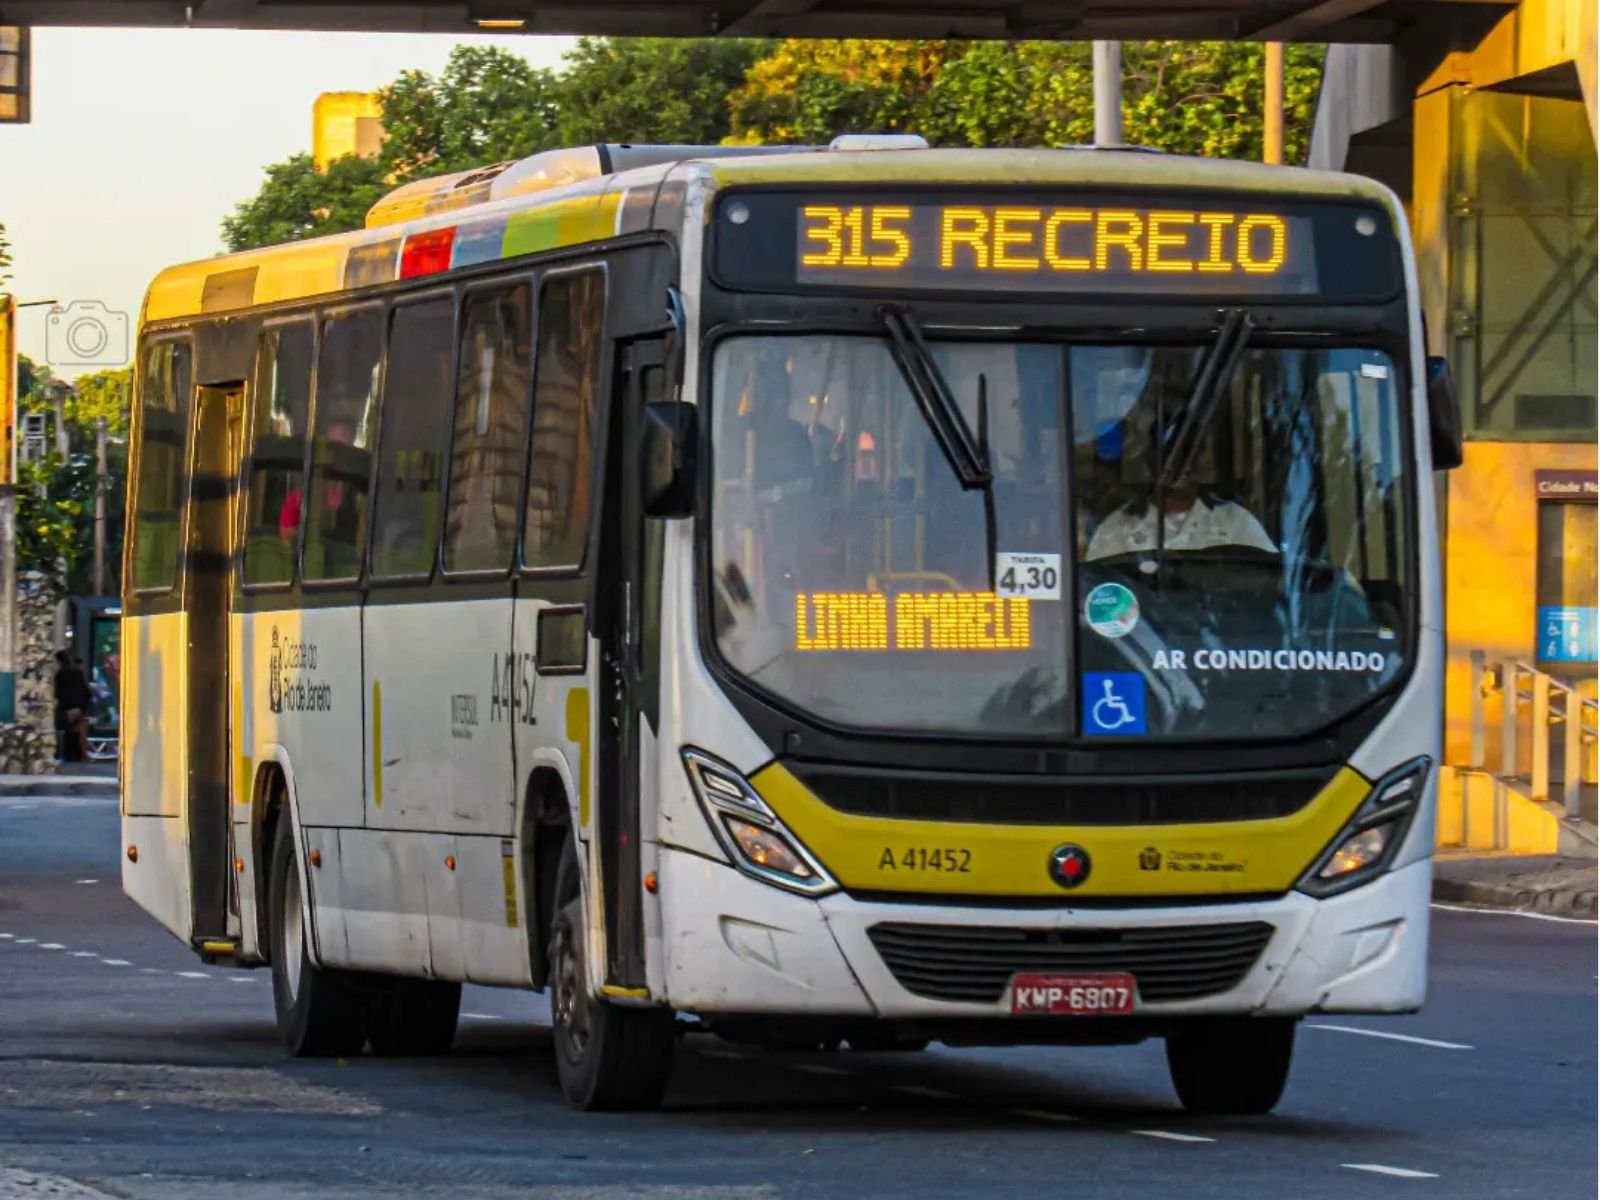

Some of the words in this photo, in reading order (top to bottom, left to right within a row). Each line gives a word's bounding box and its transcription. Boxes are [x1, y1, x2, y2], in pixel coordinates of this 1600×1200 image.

[803, 206, 911, 266] 315
[940, 208, 1286, 274] RECREIO
[999, 566, 1057, 594] 4,30
[1152, 650, 1187, 670] AR
[1193, 649, 1385, 672] CONDICIONADO
[879, 848, 897, 870] A
[902, 848, 972, 873] 41452
